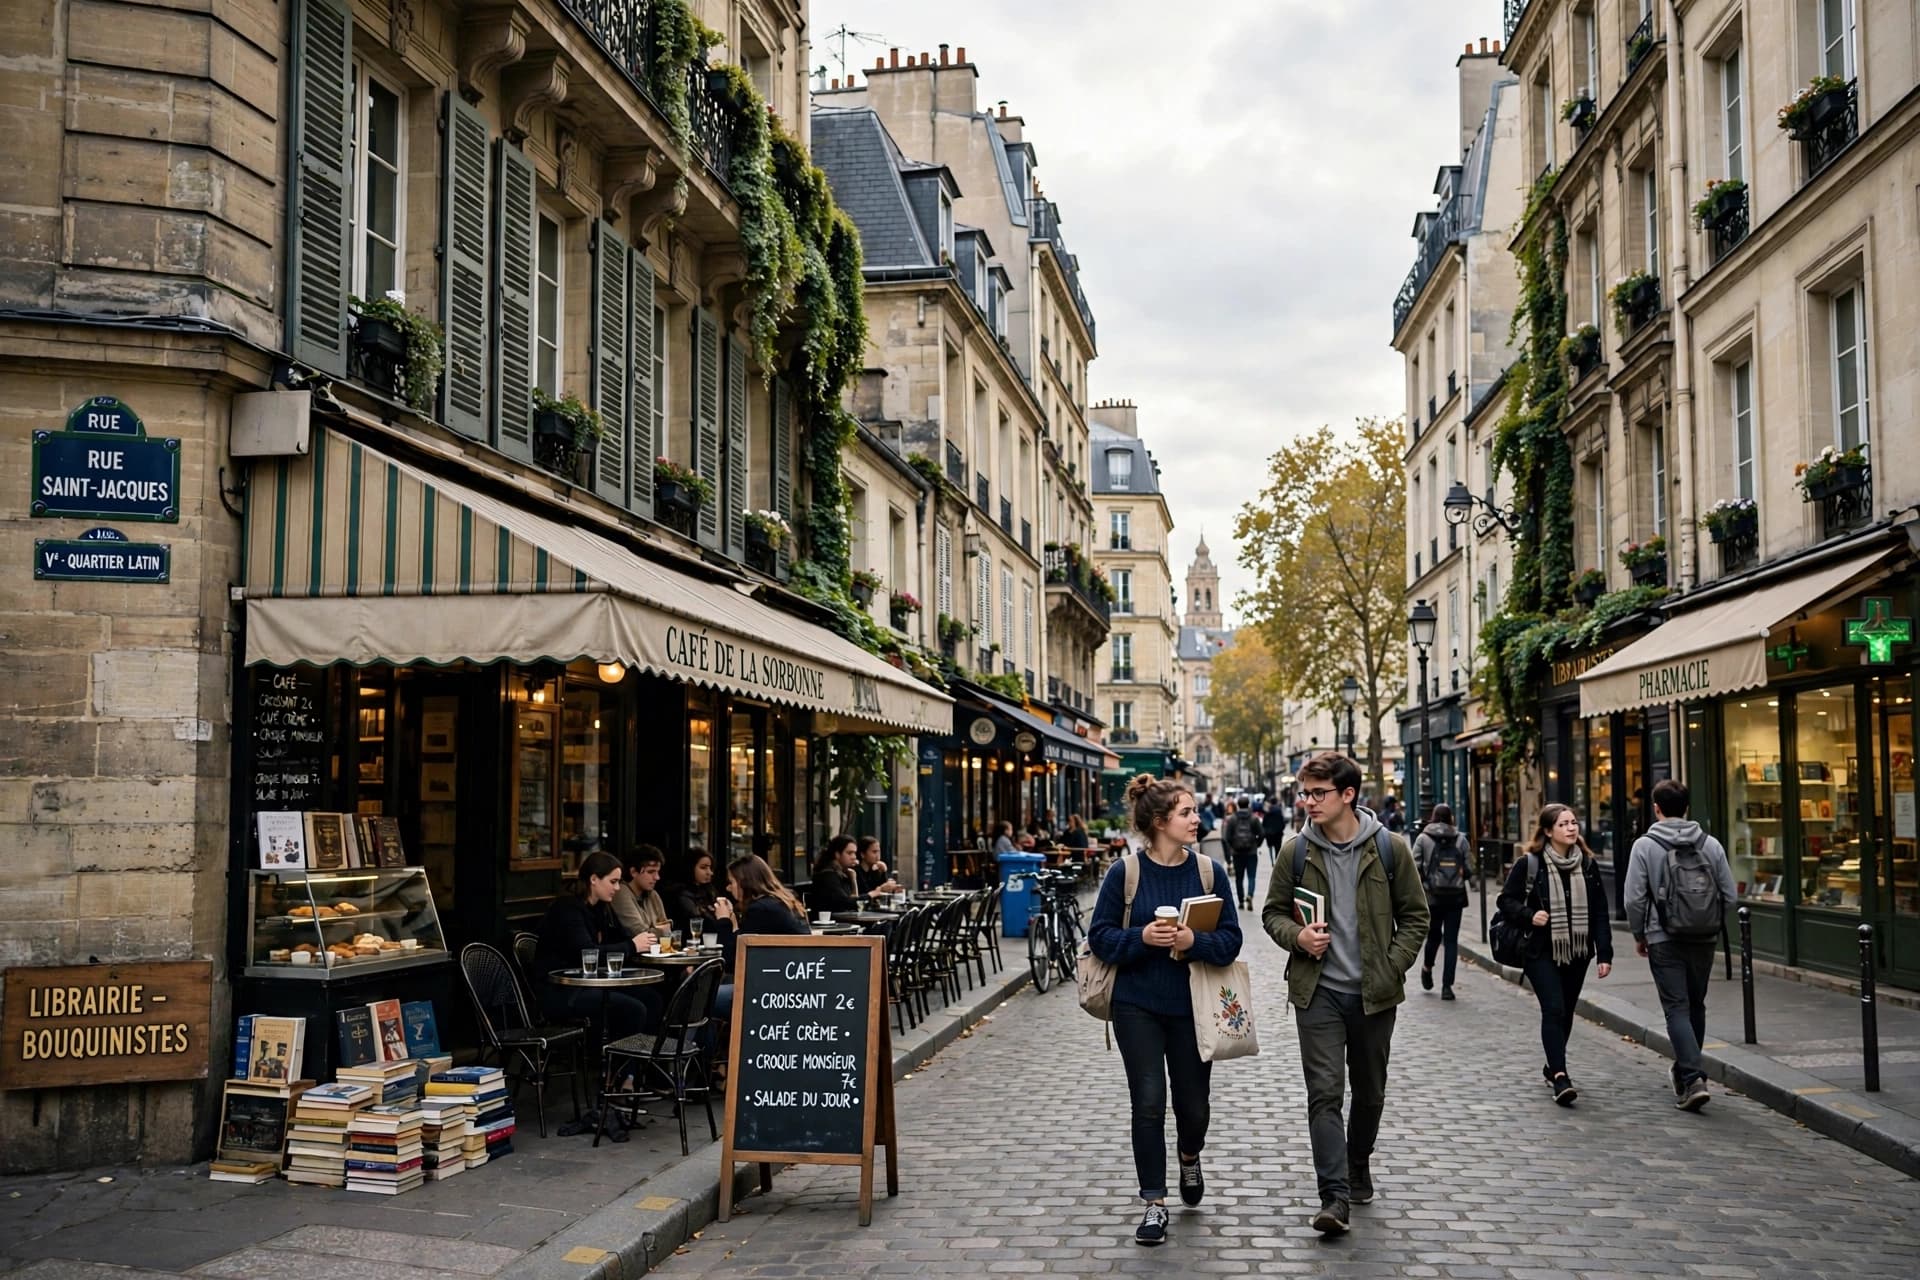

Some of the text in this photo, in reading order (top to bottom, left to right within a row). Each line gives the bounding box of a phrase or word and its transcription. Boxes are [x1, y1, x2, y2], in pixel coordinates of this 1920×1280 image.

[88, 413, 120, 430] RUE
[88, 450, 123, 470] RUE
[42, 476, 168, 501] SAINT-JACQUES
[67, 554, 124, 569] QUARTIER
[128, 555, 160, 570] LATIN
[666, 625, 709, 672] CAFÉ
[714, 640, 735, 678] DE
[740, 648, 758, 684] LA
[762, 655, 825, 700] SORBONNE
[1639, 659, 1710, 700] PHARMACIE
[785, 957, 826, 980] CAFÉ
[30, 985, 144, 1017] LIBRAIRIE
[760, 993, 855, 1010] CROISSANT 2€
[758, 1021, 839, 1041] CAFÉ CRÈME
[22, 1023, 189, 1060] BOUQUINISTES
[756, 1053, 798, 1071] CROQUE
[841, 1073, 857, 1090] 7€
[753, 1090, 851, 1108] SALADE DU JOUR
